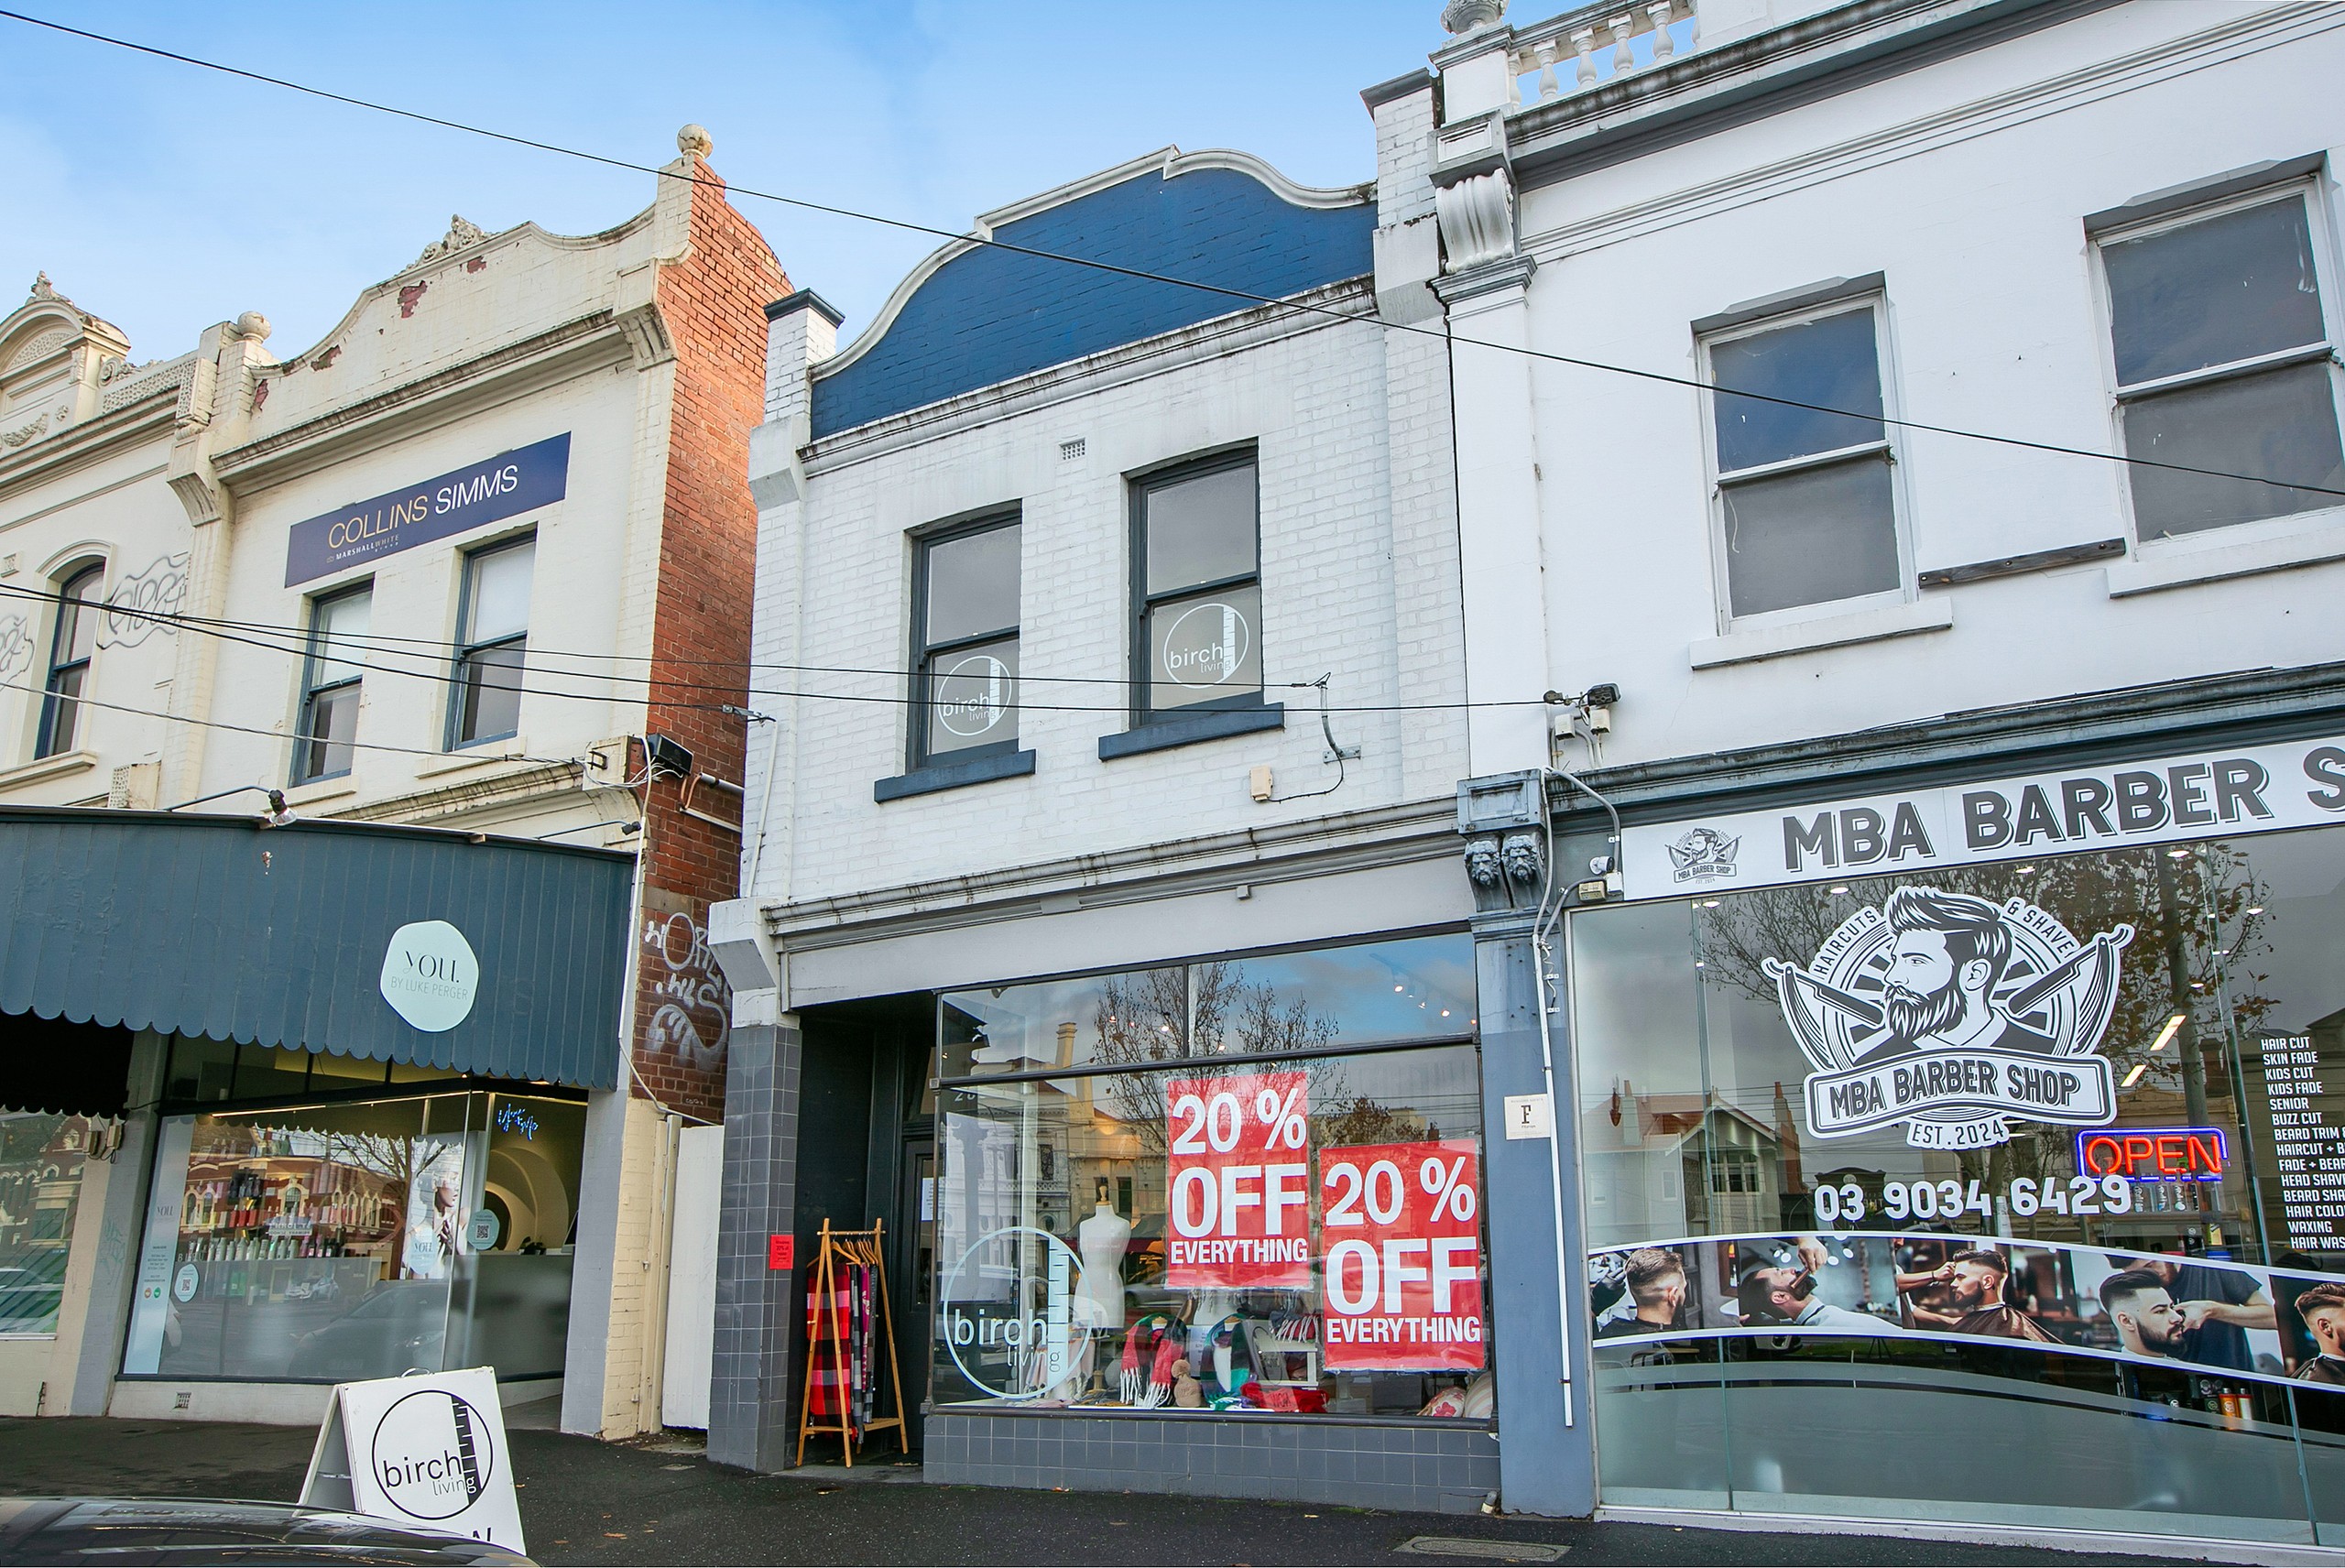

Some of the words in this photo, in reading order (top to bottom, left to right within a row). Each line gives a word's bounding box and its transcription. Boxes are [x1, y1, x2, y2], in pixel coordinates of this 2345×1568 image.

[327, 495, 428, 549] COLLINS
[434, 464, 518, 515] SIMMS
[1170, 642, 1223, 670] birch
[1200, 660, 1231, 673] living
[943, 691, 989, 717] birch
[969, 710, 997, 722] living
[1783, 801, 1936, 873] MBA
[1961, 757, 2274, 851] BARBER
[1678, 870, 1691, 880] MBA
[1692, 865, 1715, 876] BARBER
[1716, 865, 1731, 874] SHOP
[2007, 900, 2020, 914] &
[2023, 909, 2076, 959] SHAVE
[1813, 909, 1877, 975] HAIRCUTS
[391, 975, 404, 989] BY
[405, 979, 430, 995] LUKE
[431, 984, 469, 1000] PERGER
[2261, 1038, 2287, 1051] HAIR
[2289, 1036, 2309, 1050] CUT
[2263, 1052, 2288, 1065] SKIN
[2290, 1051, 2318, 1063] FADE
[2265, 1068, 2291, 1081] KIDS
[2293, 1066, 2314, 1079] CUT
[1829, 1075, 1886, 1120] MBA
[1893, 1059, 1998, 1102] BARBER
[2007, 1065, 2081, 1107] SHOP
[2267, 1083, 2294, 1095] KIDS
[2295, 1081, 2324, 1094] FADE
[1521, 1104, 1532, 1125] F
[2269, 1097, 2310, 1110] SENIOR
[1172, 1091, 1242, 1155] 20
[1256, 1087, 1307, 1150] %
[2272, 1113, 2299, 1126] BUZZ
[2301, 1112, 2322, 1125] CUT
[2274, 1127, 2310, 1141] BEARD
[2311, 1127, 2340, 1139] TRIM
[2084, 1134, 2223, 1175] OPEN
[2276, 1142, 2323, 1156] HAIRCUT
[2278, 1159, 2307, 1171] FADE
[1325, 1160, 1404, 1226] 20
[1420, 1156, 1477, 1223] %
[2281, 1174, 2310, 1186] HEAD
[1171, 1162, 1307, 1238] OFF
[1814, 1183, 1865, 1222] 03
[1883, 1179, 1991, 1220] 9034
[2009, 1173, 2132, 1217] 6429
[2283, 1190, 2320, 1203] BEARD
[2322, 1189, 2345, 1202] SHA
[2285, 1205, 2313, 1217] HAIR
[2315, 1204, 2345, 1217] COLO
[2287, 1221, 2333, 1233] WAXING
[1171, 1237, 1308, 1265] EVERYTHING
[2291, 1236, 2318, 1248] HAIR
[1326, 1236, 1478, 1316] OFF
[954, 1308, 1047, 1345] birch
[1326, 1316, 1480, 1344] EVERYTHING
[1008, 1346, 1061, 1373] living
[383, 1450, 463, 1488] birch
[432, 1475, 476, 1497] living
